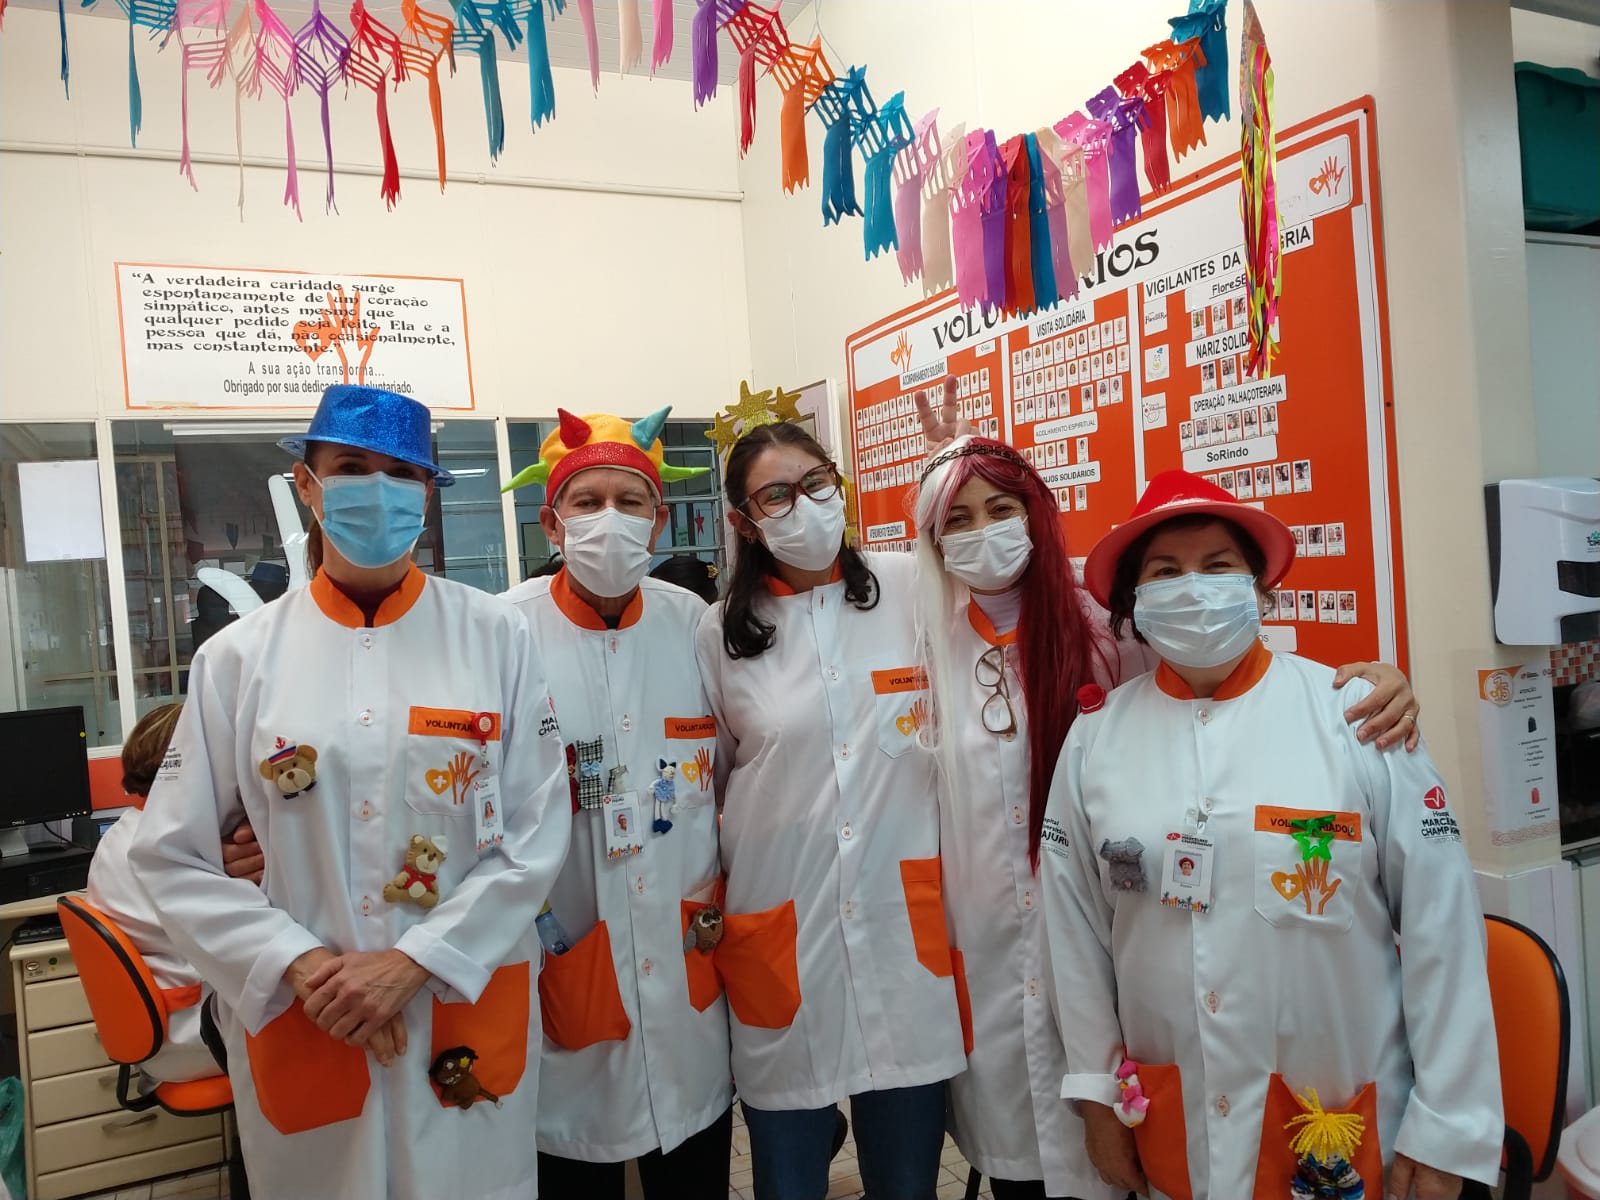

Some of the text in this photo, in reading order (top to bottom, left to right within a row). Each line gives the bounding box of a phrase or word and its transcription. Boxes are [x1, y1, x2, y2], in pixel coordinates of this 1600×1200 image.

[1145, 260, 1216, 297] VIGILANTES
[1222, 251, 1241, 270] DA
[1212, 272, 1246, 296] FloreSE
[166, 275, 261, 288] verdadeira
[270, 279, 341, 291] caridade
[351, 283, 396, 295] surge
[142, 288, 429, 308] espontaneamente de um coração
[143, 300, 395, 320] simpático, antes mesmo que
[144, 312, 450, 333] qualquer pedido seja feito. Ela e a
[1035, 308, 1087, 337] VISITA SOLIDÁRIA
[146, 328, 456, 346] pessoa que dá, não ocasionalmente,
[146, 341, 184, 352] mas
[1196, 331, 1250, 360] NARIZ SOLID
[248, 361, 385, 378] A sua ação transorma...
[223, 379, 265, 396] Obrigado
[266, 382, 281, 396] por
[283, 382, 300, 393] sua
[1193, 382, 1283, 413] OPERAÇÃO PALHAÇOTERAPIA
[1206, 446, 1249, 463] SoRindo
[1059, 468, 1096, 481] SOLIDÁRIOS
[425, 719, 473, 732] VOLUNTAR
[1041, 829, 1070, 847] AJURU
